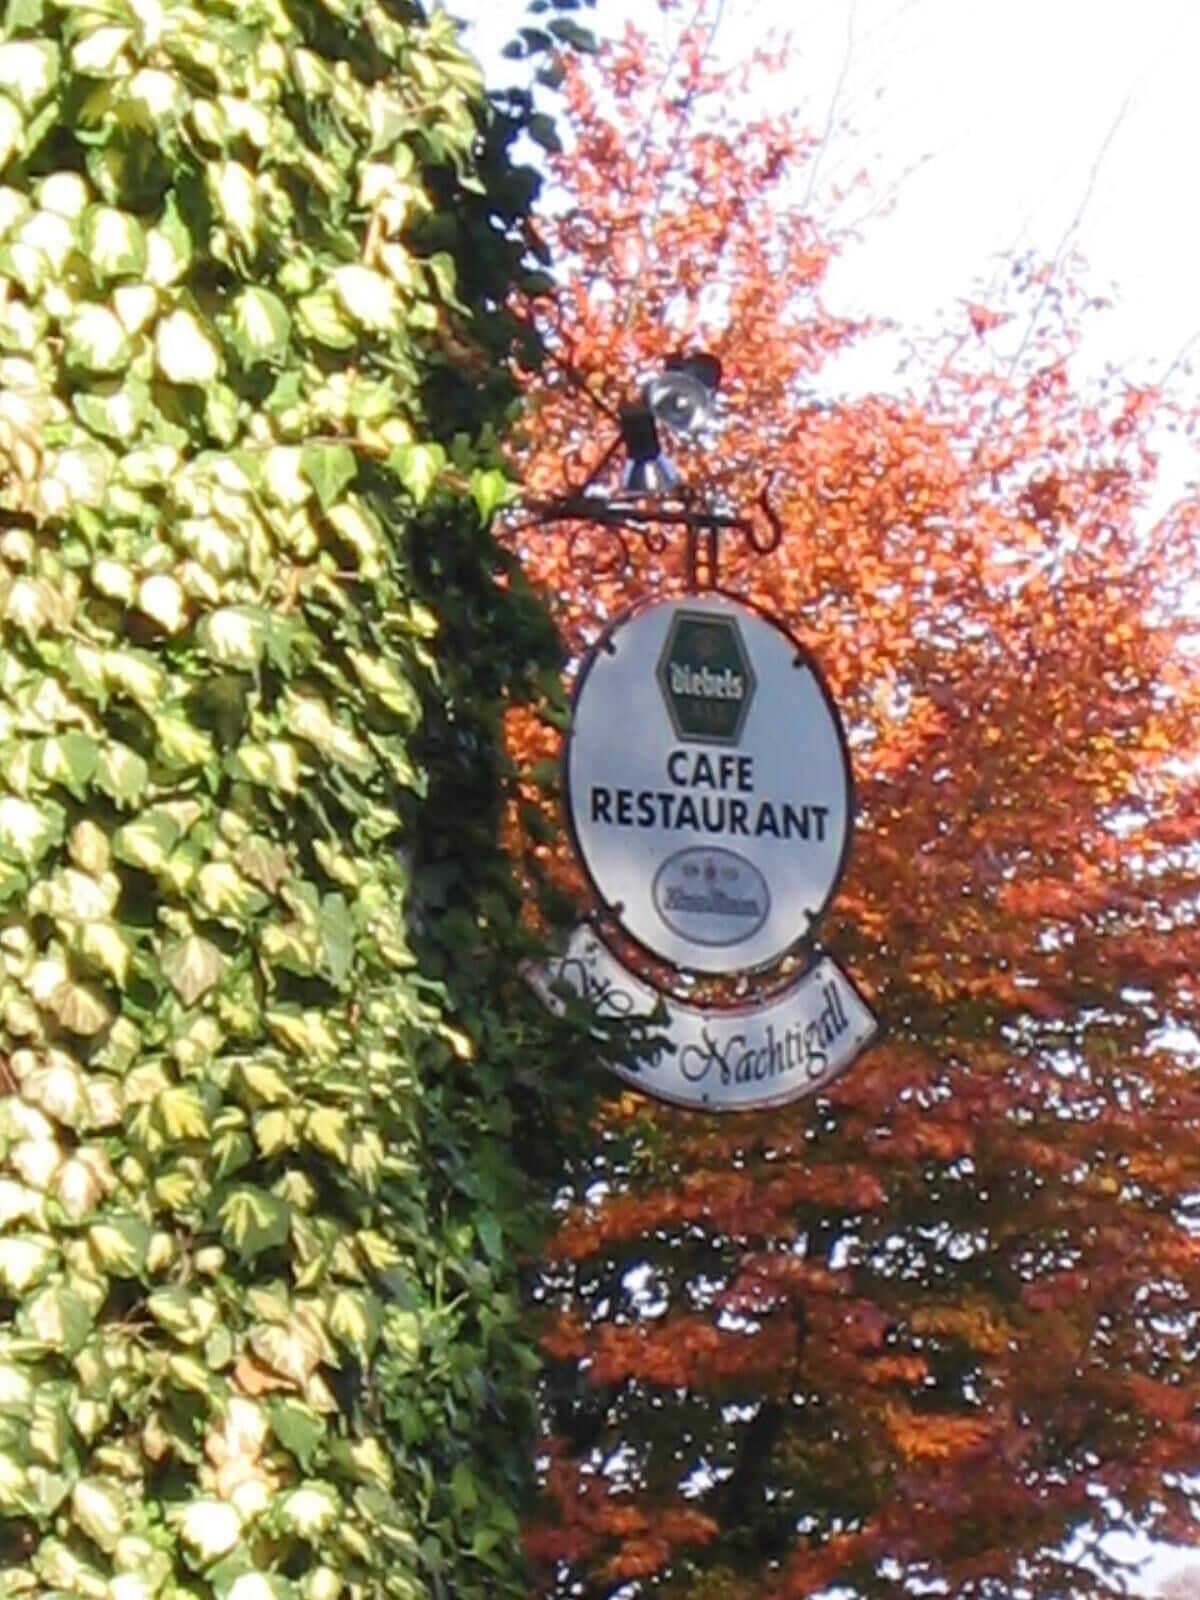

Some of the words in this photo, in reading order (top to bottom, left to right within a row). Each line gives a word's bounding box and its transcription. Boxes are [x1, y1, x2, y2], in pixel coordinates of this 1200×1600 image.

[667, 751, 755, 793] CAFE
[590, 787, 829, 842] RESTAURANT
[680, 979, 849, 1087] Nachtigall
